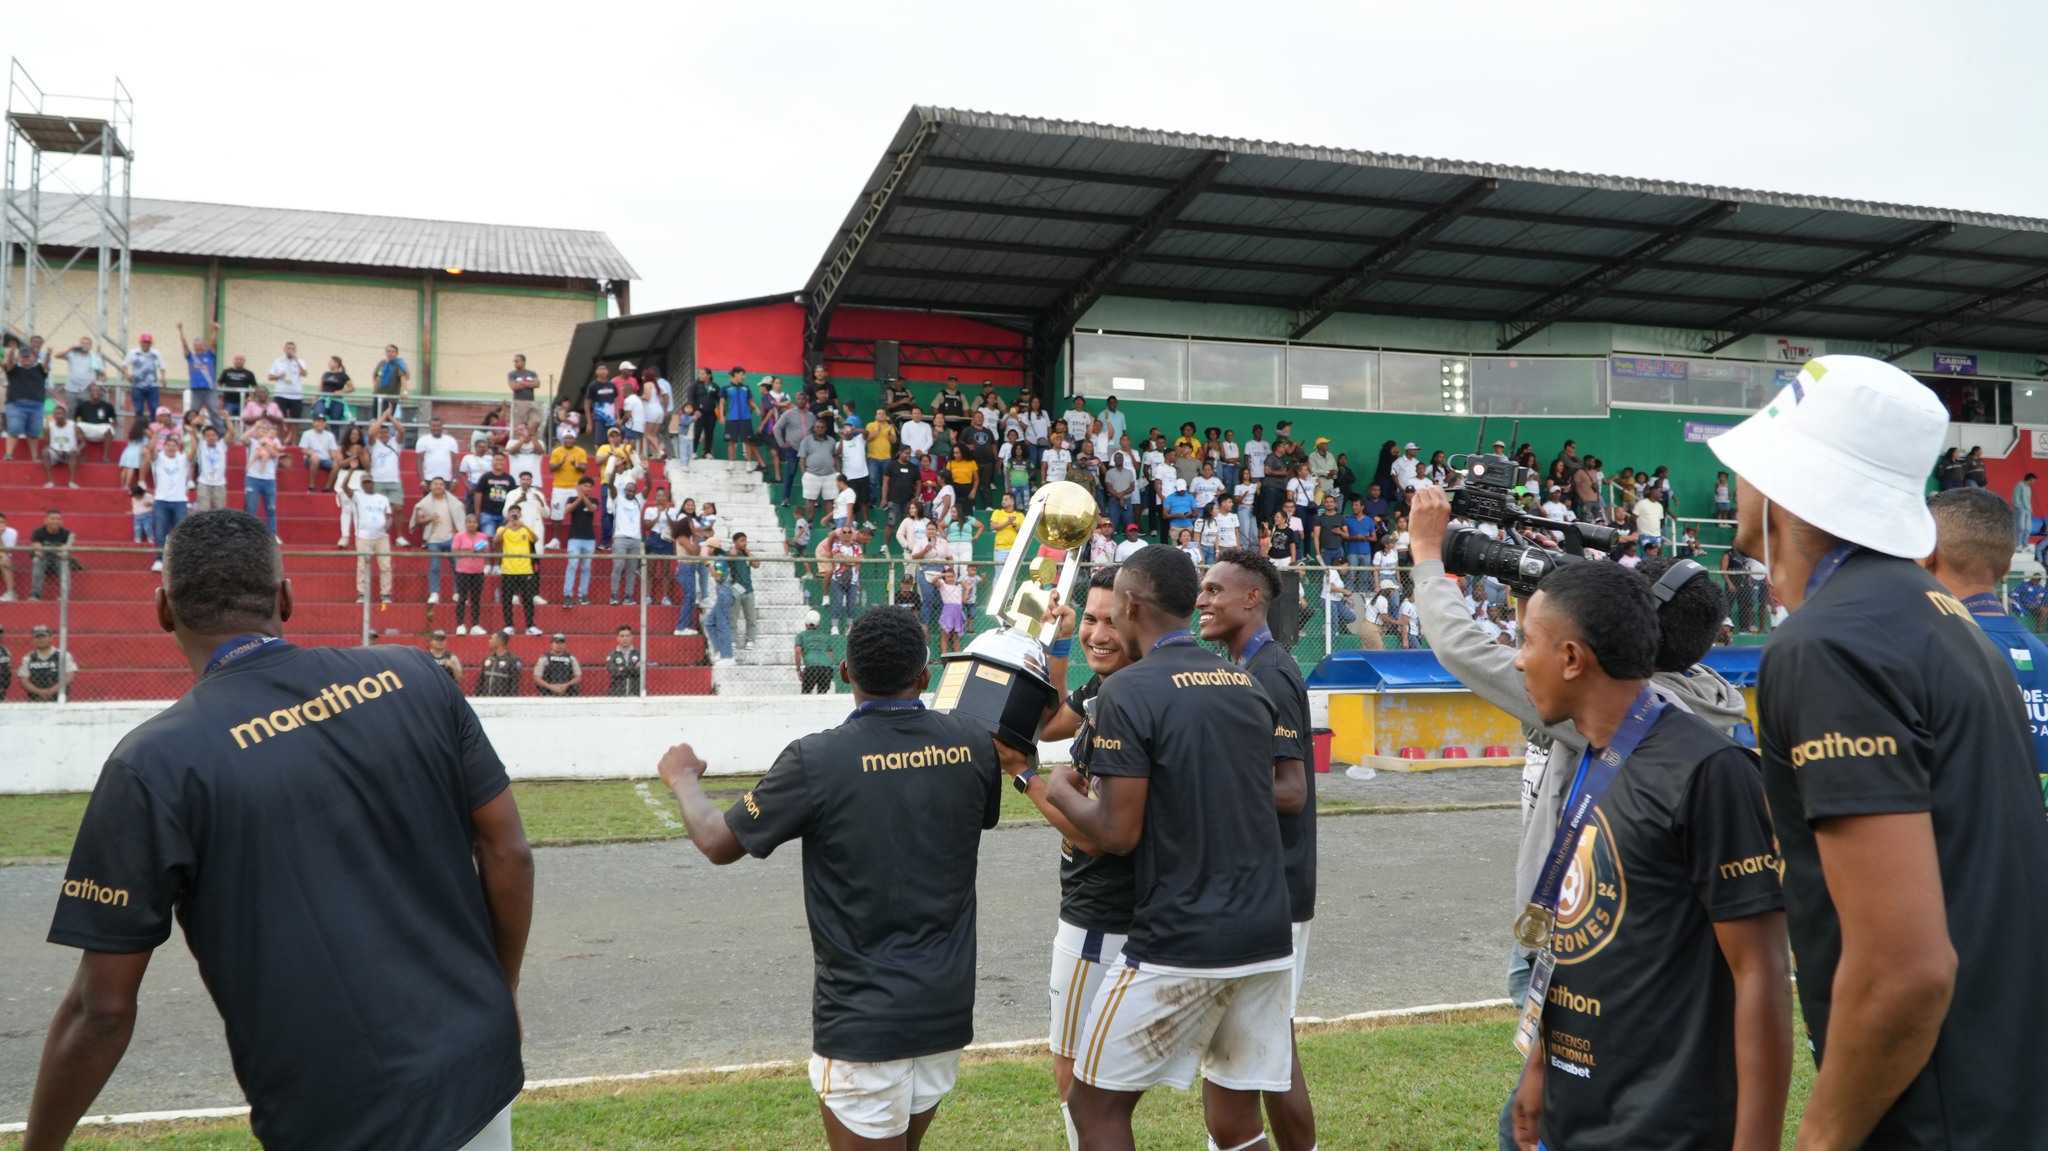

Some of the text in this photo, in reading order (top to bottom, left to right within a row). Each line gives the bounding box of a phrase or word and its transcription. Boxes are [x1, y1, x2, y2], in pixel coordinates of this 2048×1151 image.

[1665, 360, 1685, 374] FM
[1939, 357, 1972, 366] CABINA
[1171, 668, 1253, 689] marathon
[229, 669, 404, 750] marathon
[861, 745, 972, 773] marathon
[1569, 792, 1593, 830] Ecuabet
[1597, 881, 1618, 901] 24
[1552, 906, 1611, 953] EONES
[1550, 1055, 1592, 1079] Ecuabet
